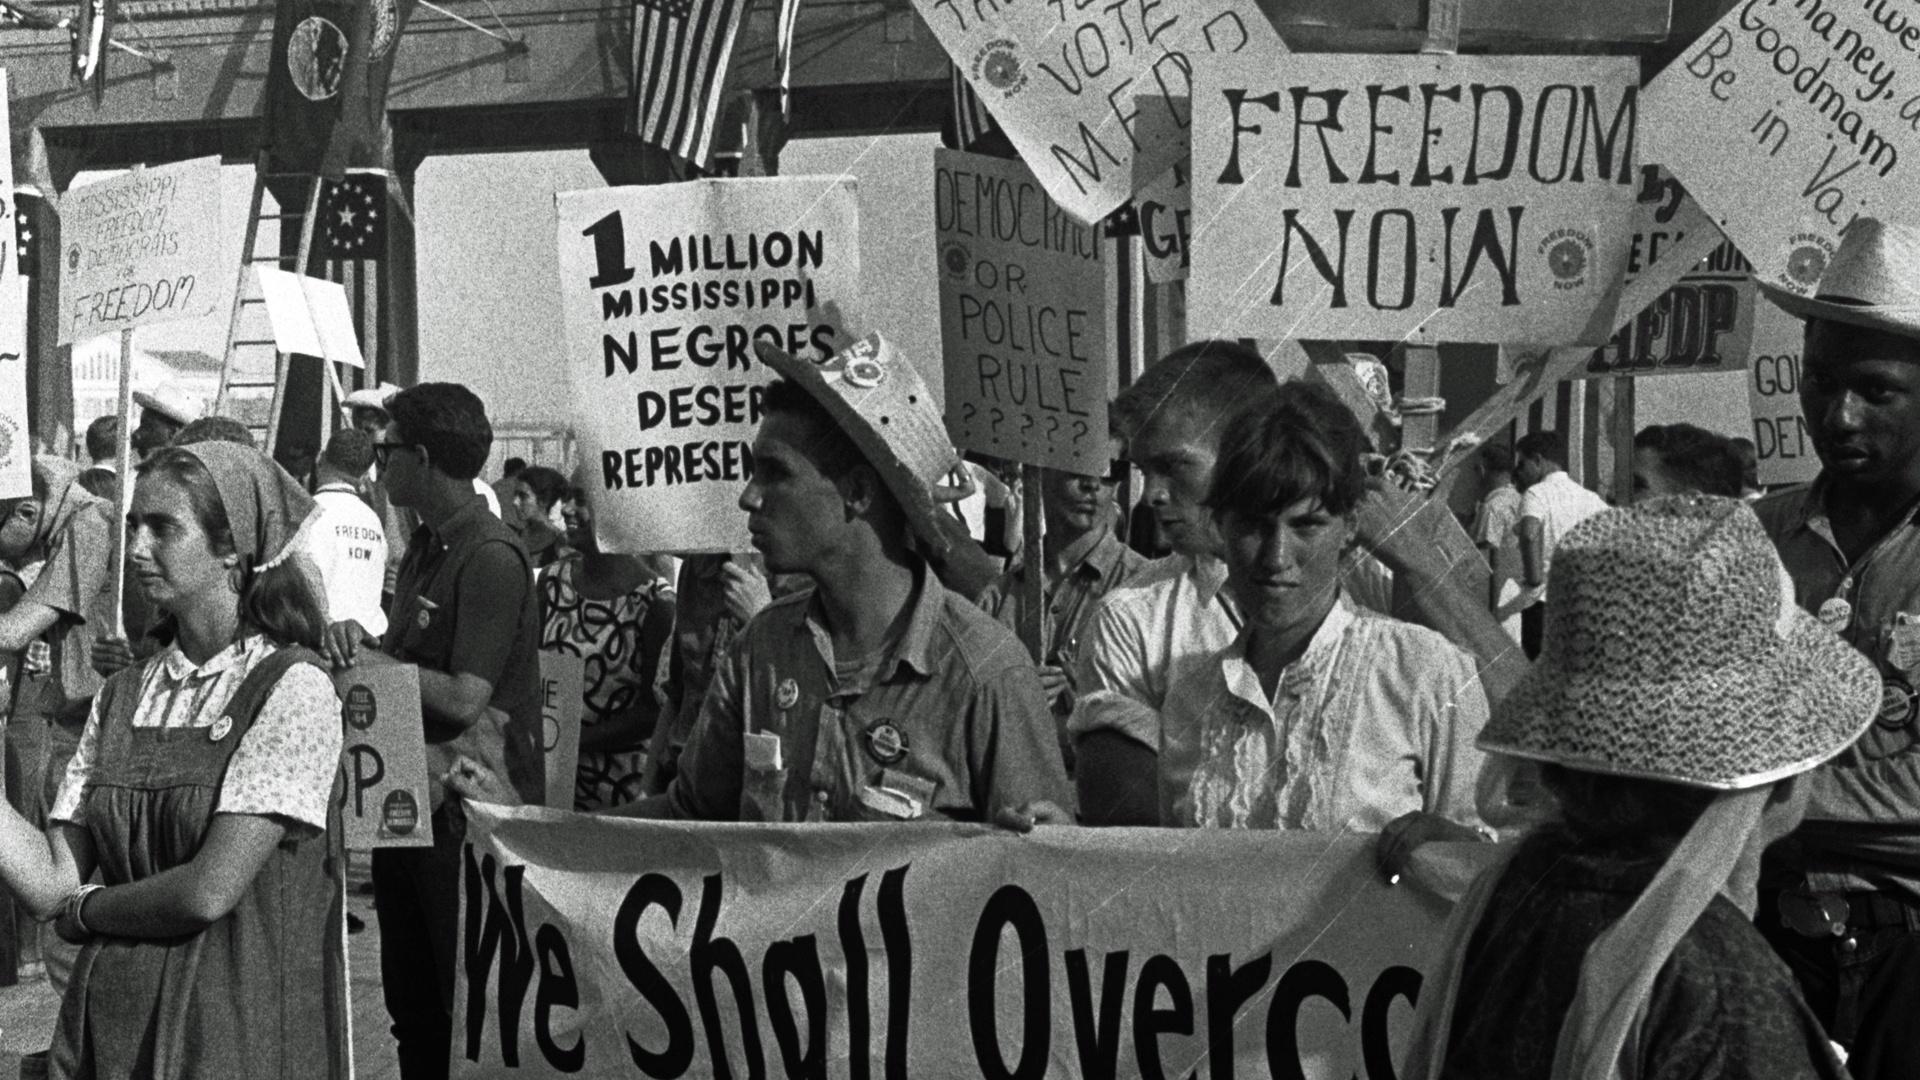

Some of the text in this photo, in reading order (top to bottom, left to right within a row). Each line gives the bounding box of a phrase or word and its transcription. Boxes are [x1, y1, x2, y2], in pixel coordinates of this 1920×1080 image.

[1037, 0, 1180, 95] VOTE
[1686, 26, 1736, 101] Be
[1217, 83, 1639, 188] FREEDOM
[1751, 100, 1789, 156] in
[582, 210, 824, 289] 1 MILLION
[1270, 205, 1525, 310] NOW
[1537, 228, 1594, 255] FREEDOM
[1788, 233, 1836, 261] FREEDO
[71, 274, 195, 333] FREEDOM
[602, 279, 816, 320] MISSISSIPPI
[975, 260, 1026, 294] OR
[1553, 277, 1585, 291] NOW
[603, 324, 835, 378] NEGROES
[959, 294, 1088, 362] POLICE
[637, 385, 766, 431] DESER
[978, 354, 1089, 417] RULE
[464, 842, 585, 1073] We
[614, 861, 912, 1080] Shall
